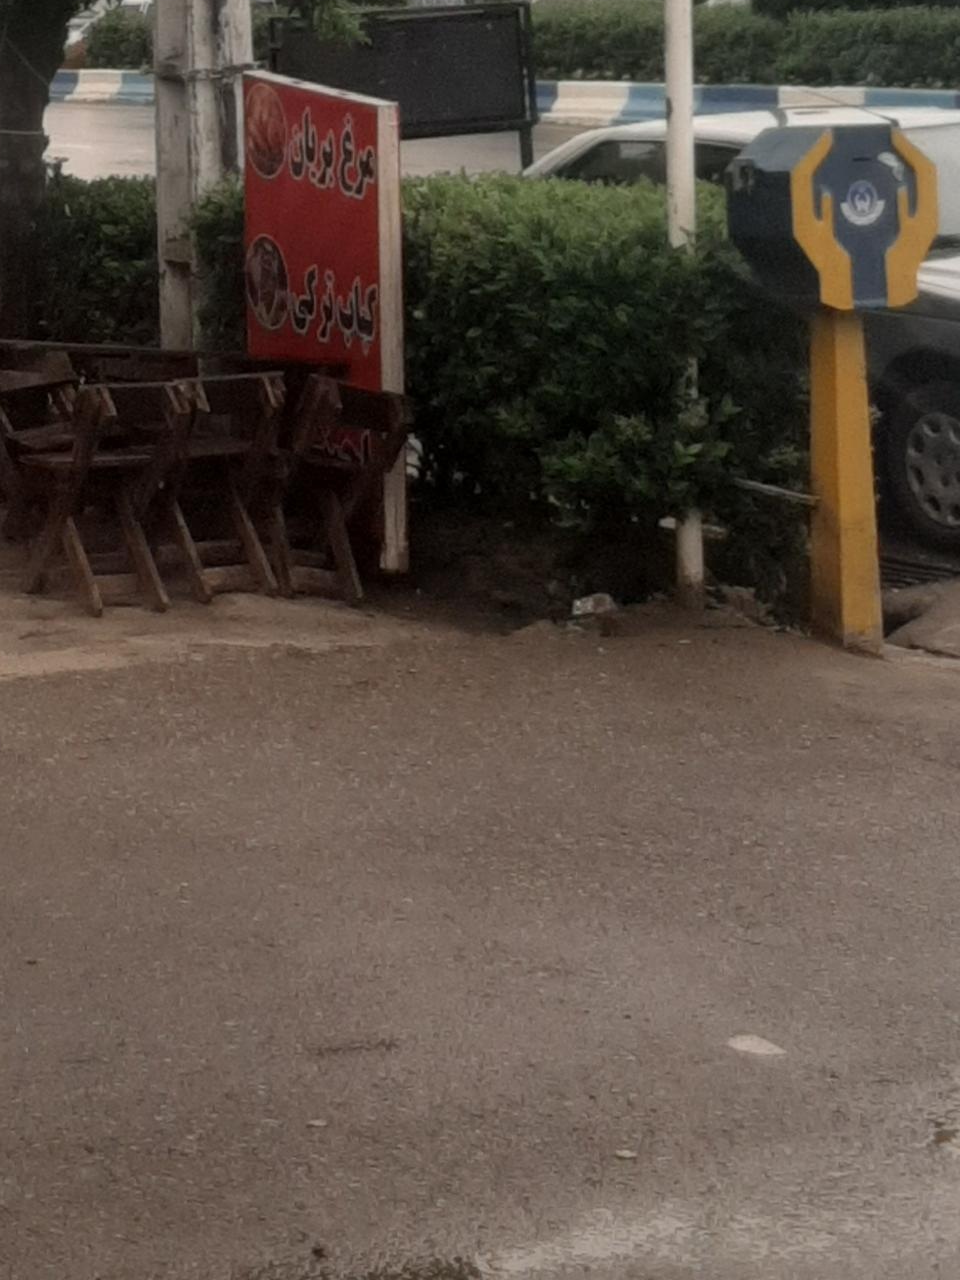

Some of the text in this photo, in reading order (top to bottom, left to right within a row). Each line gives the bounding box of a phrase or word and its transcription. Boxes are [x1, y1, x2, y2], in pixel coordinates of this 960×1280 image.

[288, 106, 375, 200] مرغ بریان
[290, 264, 379, 357] کباب ترکی
